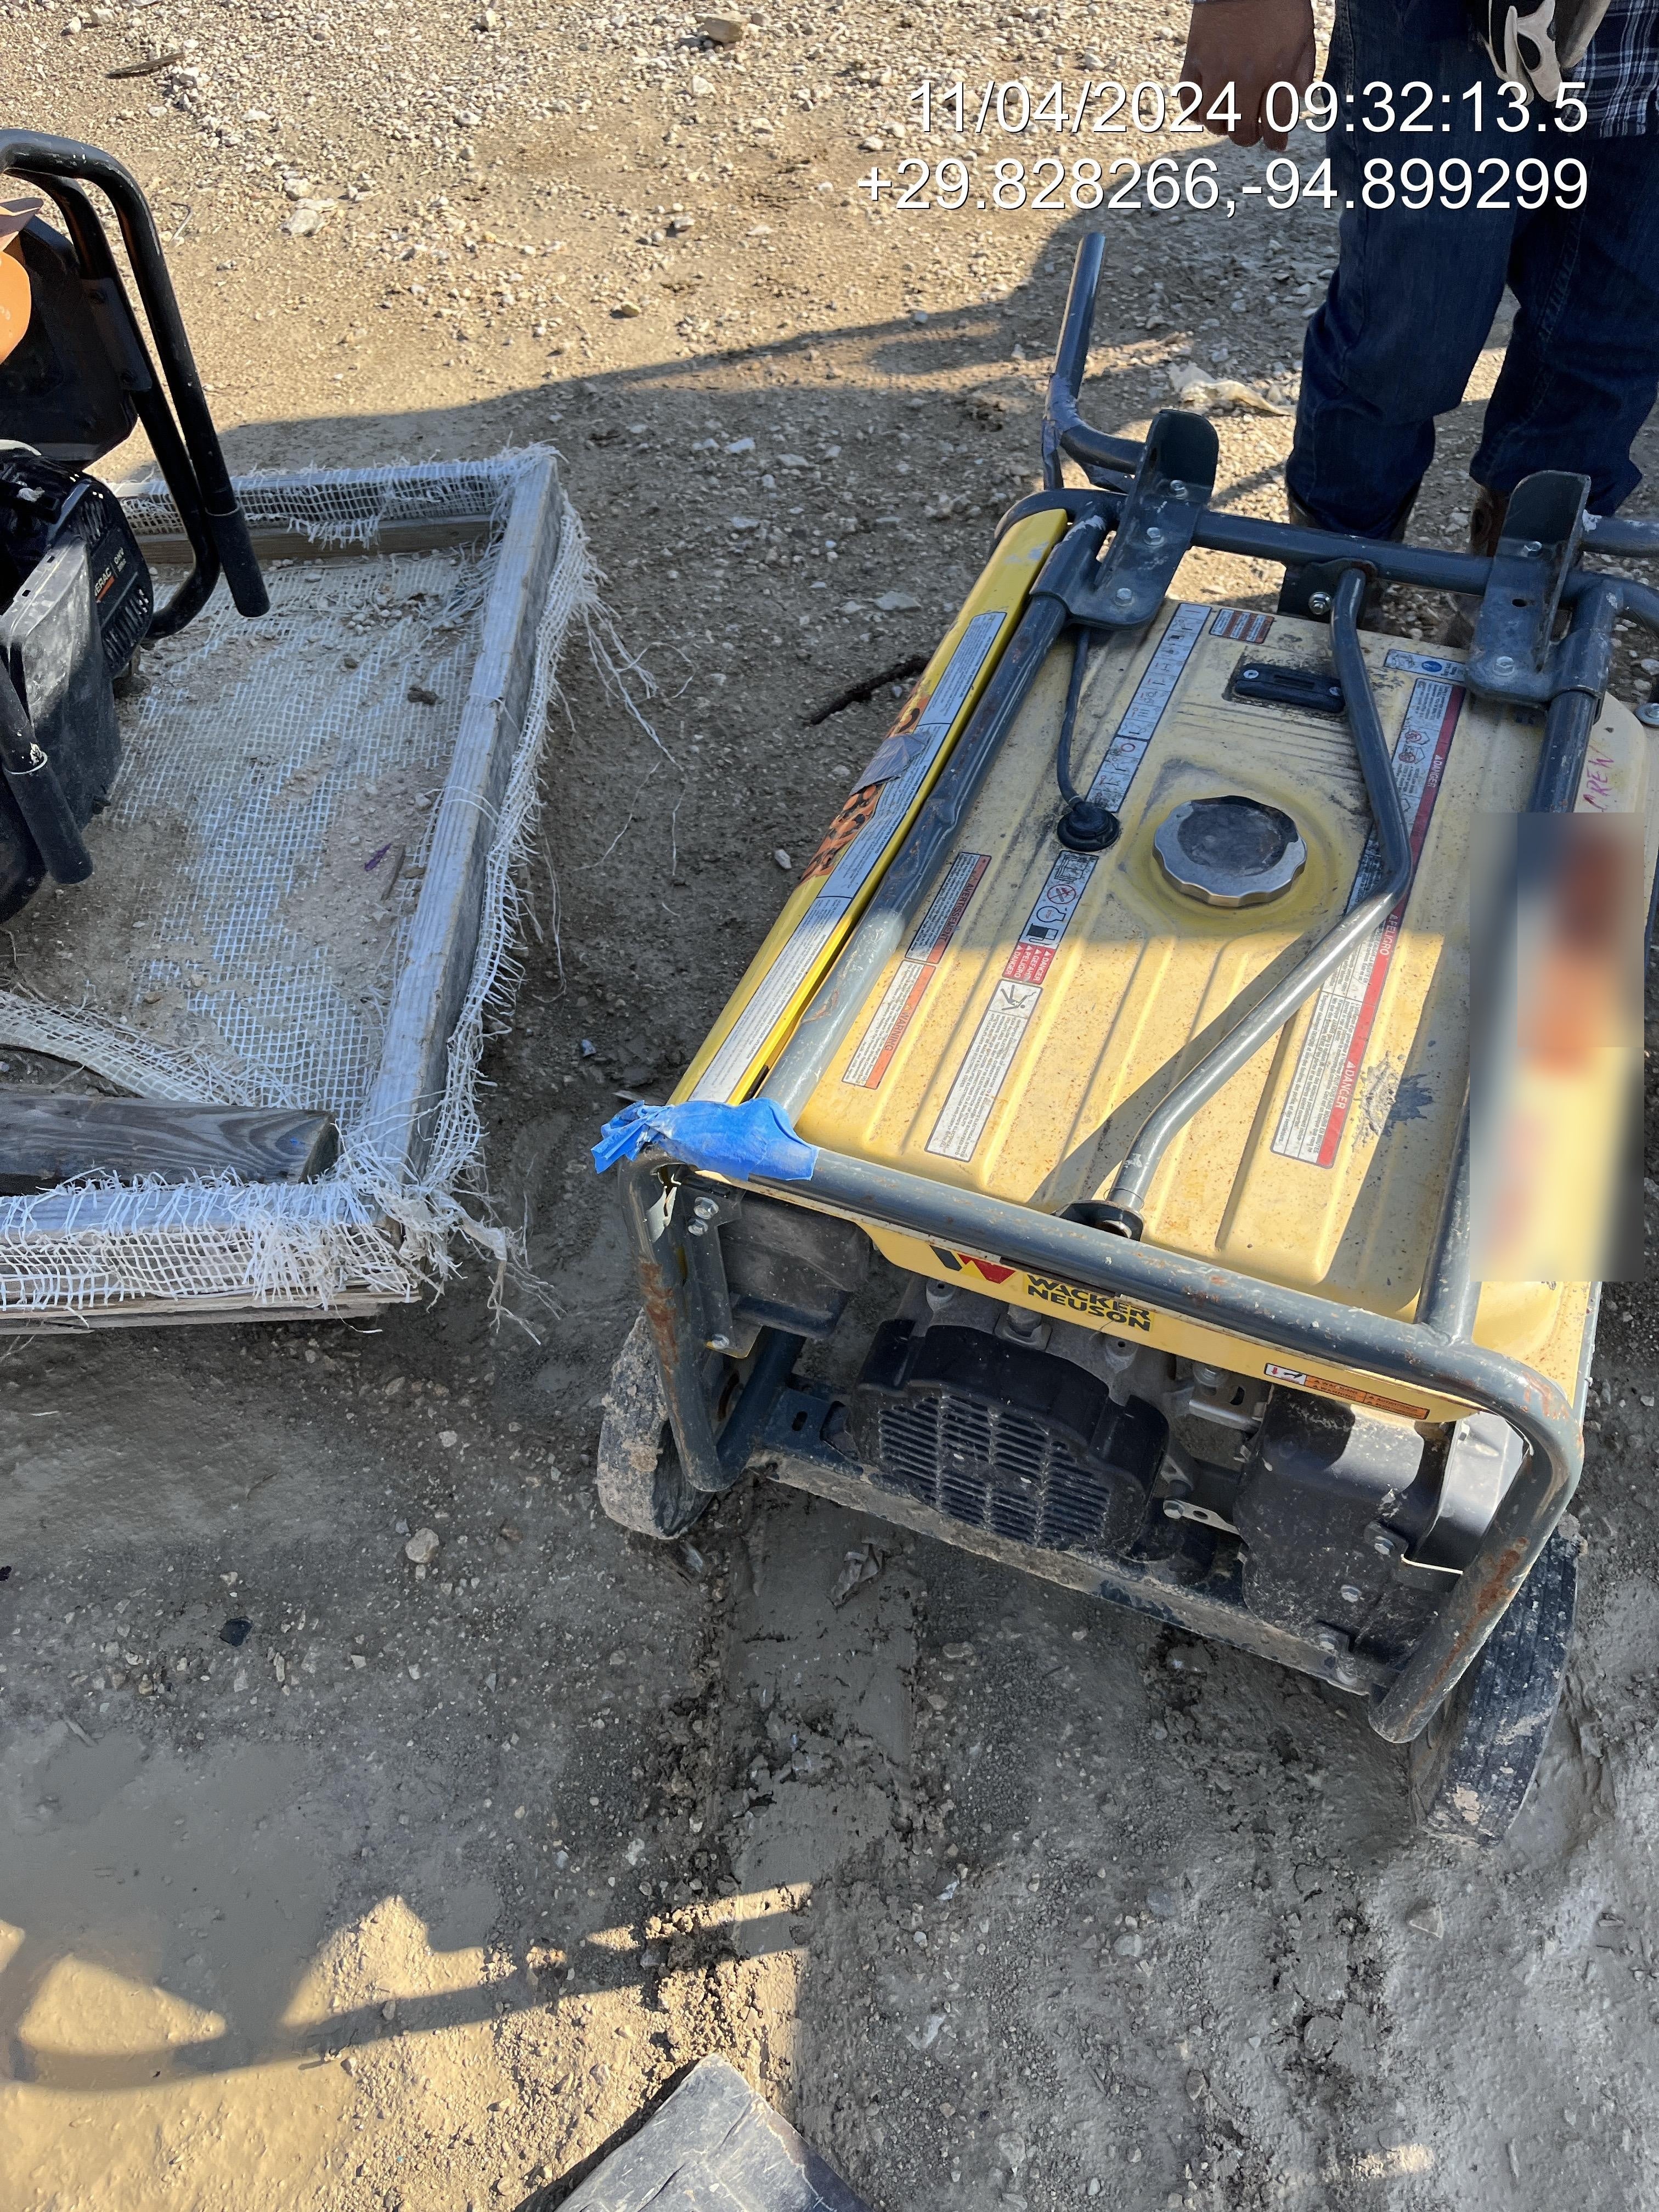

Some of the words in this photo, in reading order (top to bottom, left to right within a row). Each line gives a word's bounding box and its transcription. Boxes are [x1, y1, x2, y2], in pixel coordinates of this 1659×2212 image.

[1427, 760, 1442, 788] DANGER
[938, 883, 974, 942] AVERTISSEMENT
[1380, 920, 1398, 955] PELIGRO
[1005, 951, 1021, 975] DANGER
[1014, 951, 1031, 978] PELIGRO
[1034, 957, 1049, 980] DANGER
[883, 1012, 910, 1051] WARNING
[1335, 1069, 1355, 1109] DANGER
[1027, 1274, 1151, 1321] WACKER
[1028, 1285, 1150, 1332] NEUSON
